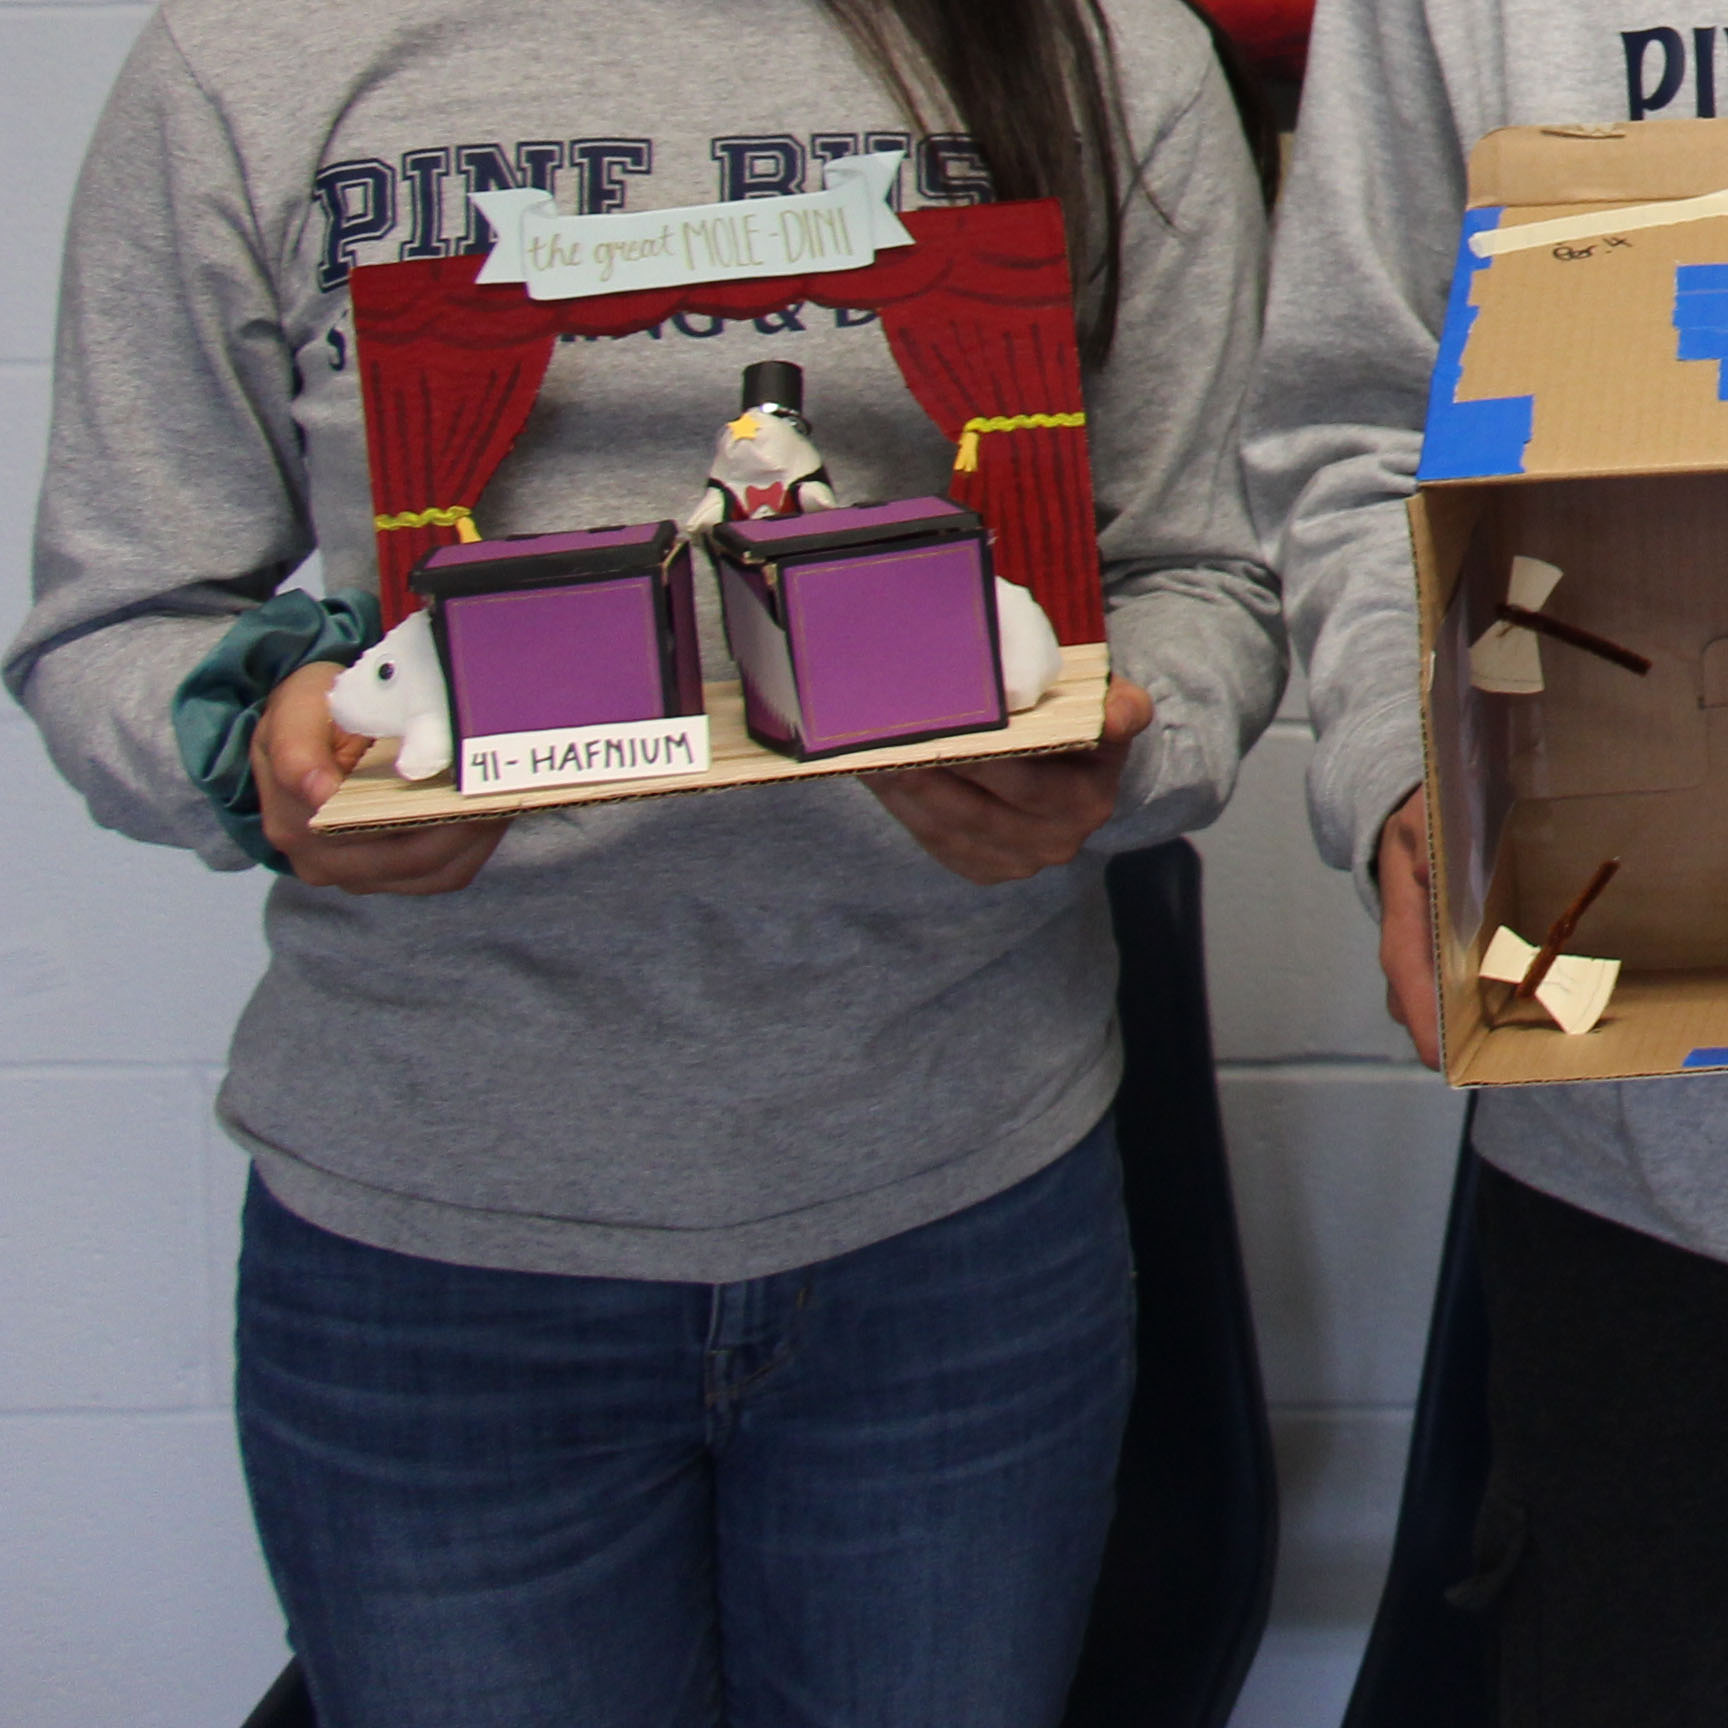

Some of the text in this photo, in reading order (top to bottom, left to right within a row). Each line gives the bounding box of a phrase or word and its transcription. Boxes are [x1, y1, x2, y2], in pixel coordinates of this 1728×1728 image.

[528, 233, 581, 271] the
[594, 224, 677, 282] great
[530, 731, 695, 774] HAFNIUM
